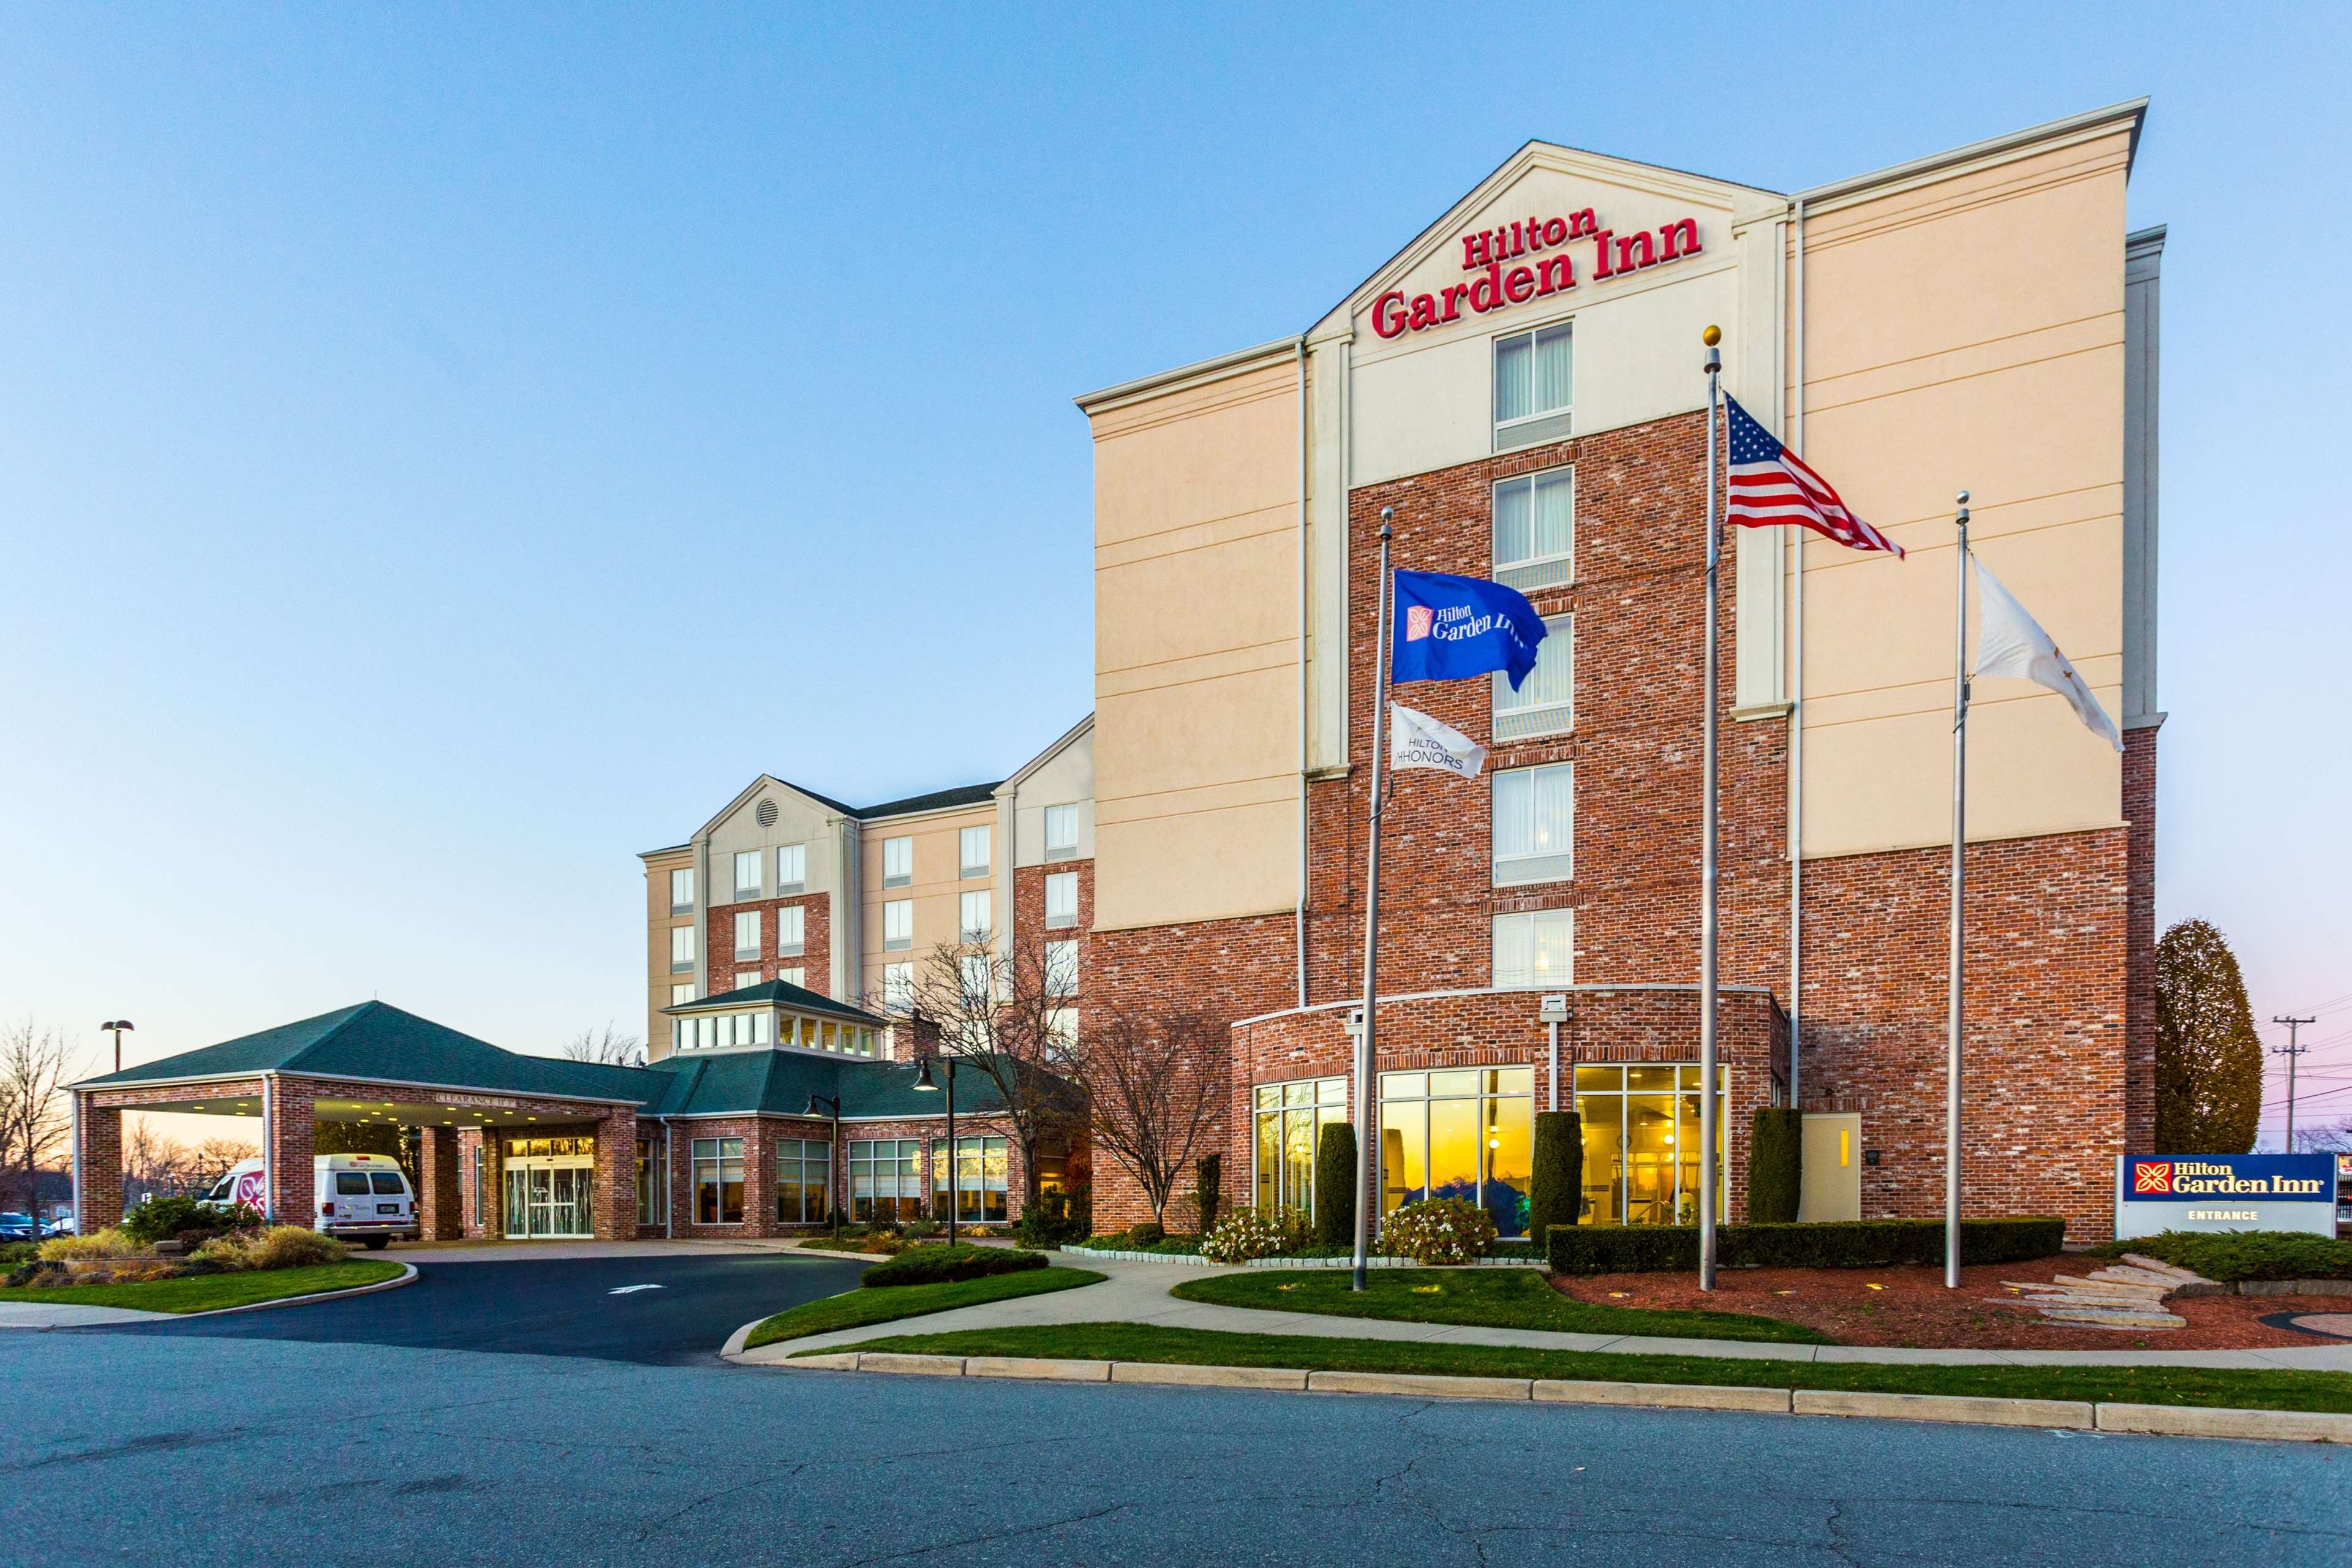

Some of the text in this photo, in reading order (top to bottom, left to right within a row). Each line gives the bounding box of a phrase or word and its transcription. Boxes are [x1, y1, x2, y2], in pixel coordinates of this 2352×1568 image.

[1461, 207, 1599, 270] Hilton
[1372, 217, 1703, 339] Garden Inn
[1436, 605, 1472, 622] Hilton
[1433, 614, 1491, 641] Garden
[437, 1093, 495, 1105] CLEARANCE
[2174, 1163, 2233, 1175] Hilton
[2173, 1175, 2269, 1194] Garden
[2188, 1211, 2258, 1221] ENTRANCE
